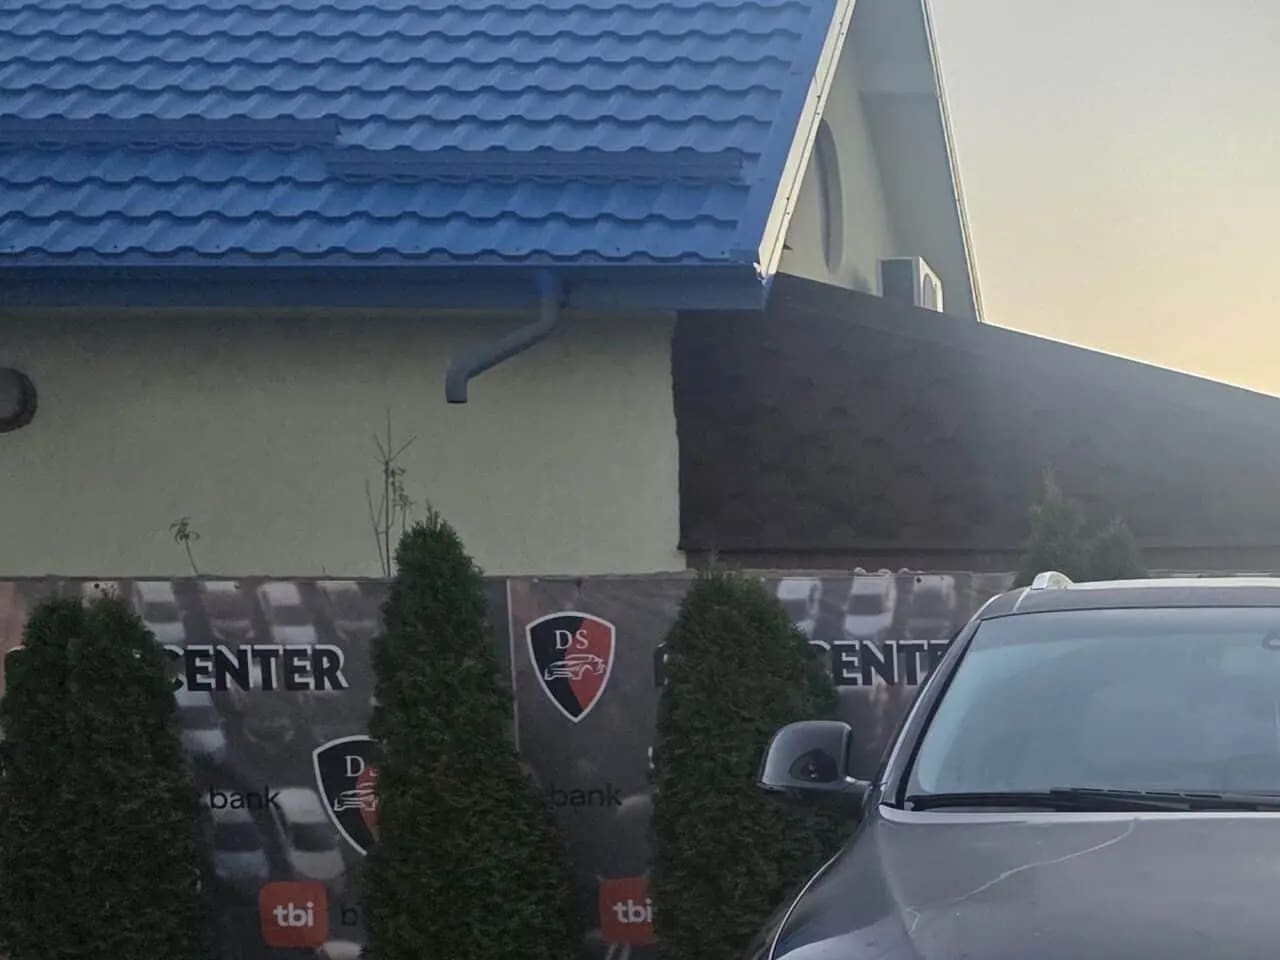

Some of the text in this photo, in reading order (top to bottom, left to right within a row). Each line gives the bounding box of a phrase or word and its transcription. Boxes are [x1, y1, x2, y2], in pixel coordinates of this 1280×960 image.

[554, 629, 589, 650] DS
[808, 639, 950, 688] ENT
[344, 755, 378, 777] D
[208, 784, 281, 810] bank
[550, 783, 622, 807] bank
[273, 901, 314, 927] tbi
[612, 898, 653, 923] tbi
